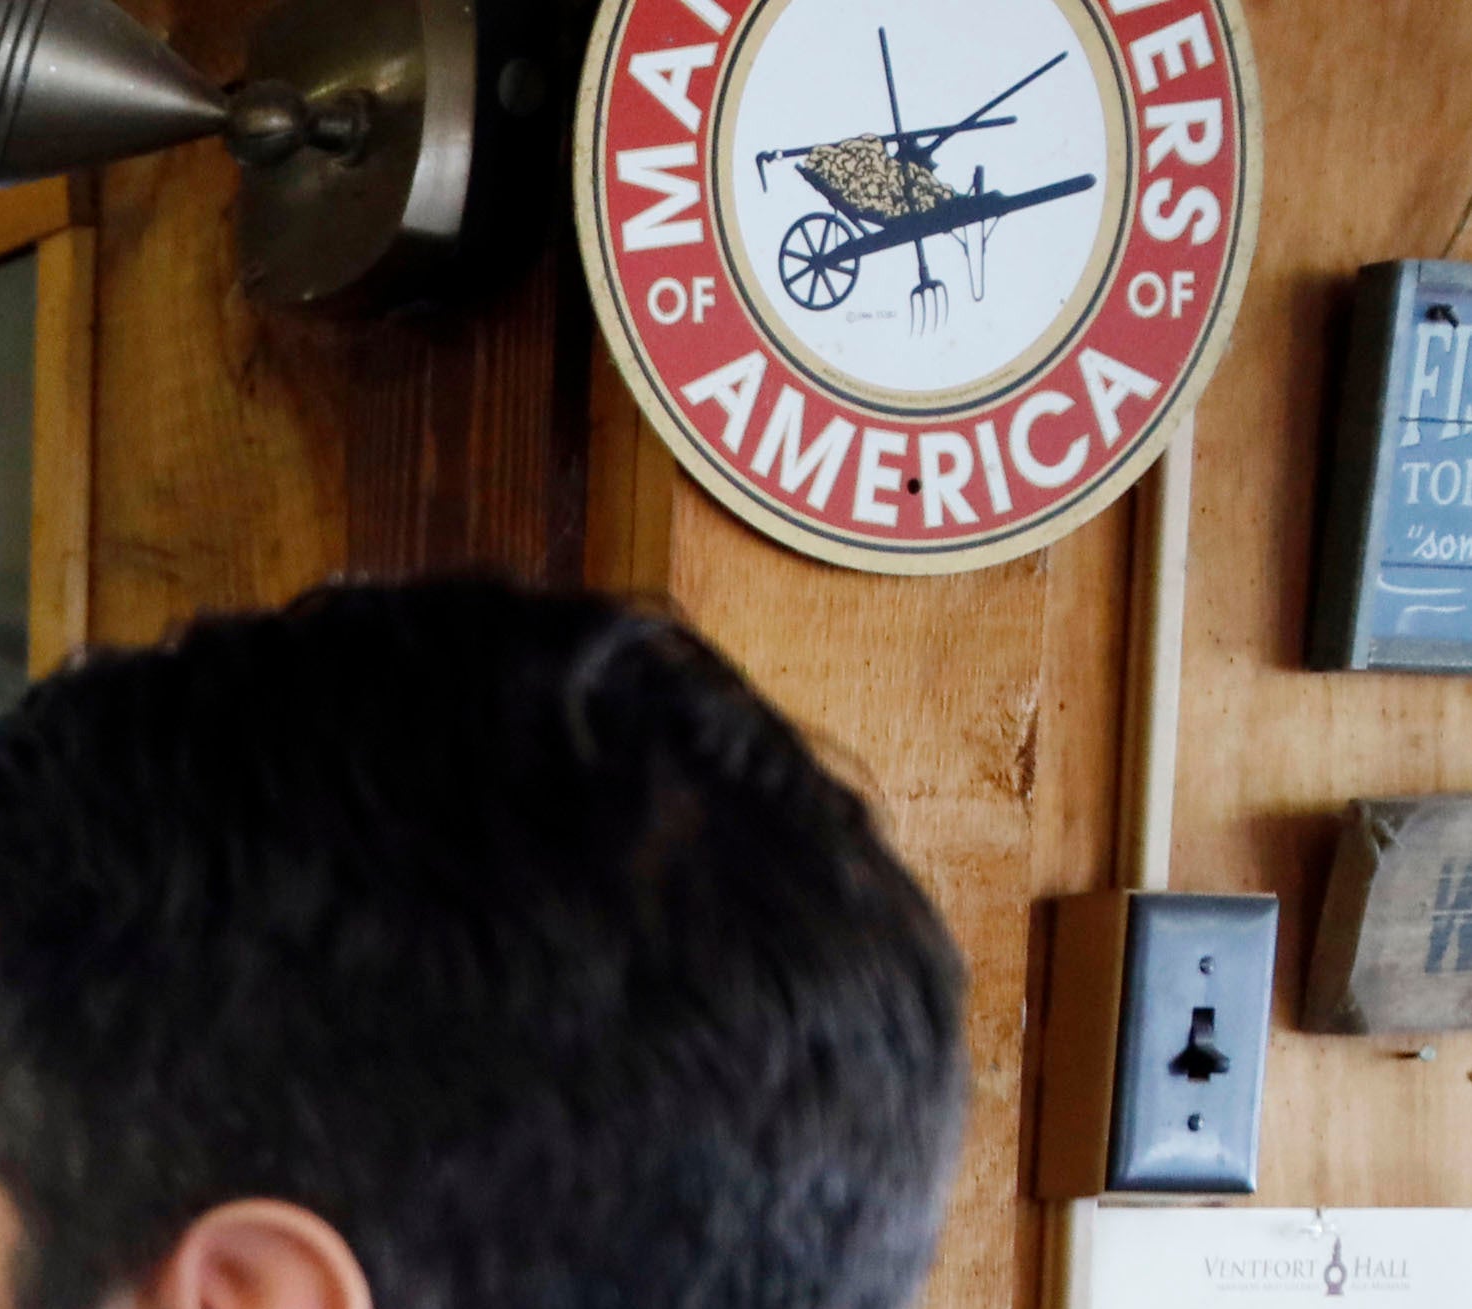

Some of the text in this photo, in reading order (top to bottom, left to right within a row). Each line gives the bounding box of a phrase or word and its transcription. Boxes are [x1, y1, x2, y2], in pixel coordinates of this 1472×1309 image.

[1108, 0, 1223, 246] ERS
[646, 276, 716, 325] OF
[1127, 271, 1195, 318] OF
[1399, 322, 1472, 448] FI
[679, 348, 1163, 528] AMERICA
[1203, 1255, 1412, 1280] VENTFORT HALL
